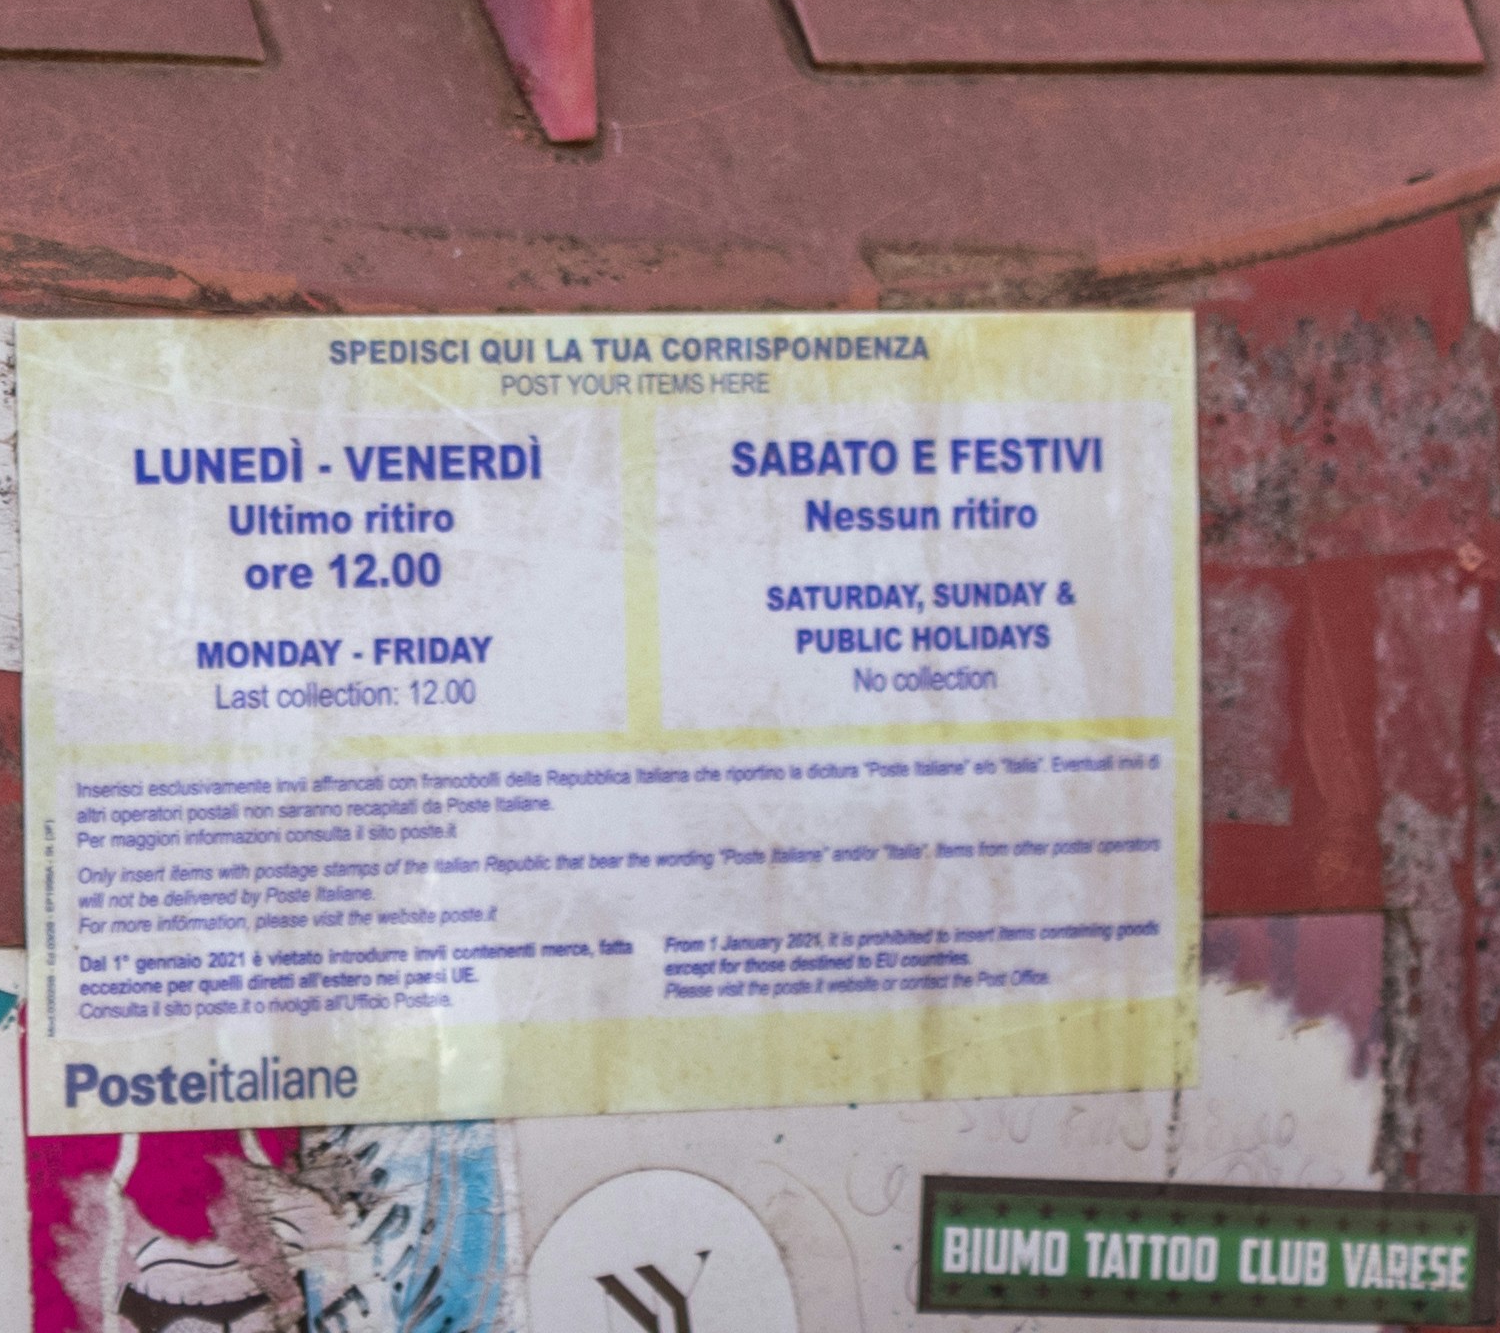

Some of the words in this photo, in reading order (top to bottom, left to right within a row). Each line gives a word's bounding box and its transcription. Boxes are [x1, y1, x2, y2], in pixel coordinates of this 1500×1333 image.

[328, 338, 471, 366] SPEDISCI
[480, 337, 535, 366] QUI
[545, 337, 582, 364] LA
[592, 336, 653, 364] TUA
[661, 335, 930, 363] CORRISPONDENZA
[501, 374, 562, 397] POST
[567, 373, 632, 396] YOUR
[637, 372, 705, 395] ITEMS
[710, 371, 770, 394] HERE
[134, 436, 304, 486] LUNEDÌ
[344, 434, 543, 482] VENERDÌ
[731, 438, 899, 478] SABATO
[912, 439, 937, 475] E
[949, 436, 1104, 474] FESTIVI
[228, 502, 352, 536] Ultimo
[365, 501, 455, 534] ritiro
[805, 498, 941, 533] Nessun
[951, 496, 1038, 530] ritiro
[244, 562, 314, 592] ore
[328, 552, 442, 589] 12.00
[766, 582, 925, 614] SATURDAY,
[933, 581, 1047, 609] SUNDAY
[1055, 579, 1077, 607] &
[196, 638, 342, 670] MONDAY
[374, 635, 493, 666] FRIDAY
[795, 626, 902, 655] PUBLIC
[912, 623, 1051, 652] HOLIDAYS
[215, 683, 270, 710] Last
[276, 680, 399, 709] collection:
[409, 678, 477, 706] 12.00
[854, 667, 887, 692] No
[893, 665, 998, 691] collection
[77, 782, 143, 799] Inserisci
[149, 779, 272, 796] esclusivamente
[313, 775, 384, 792] affrancati
[389, 776, 416, 791] con
[506, 771, 542, 787] della
[547, 769, 631, 789] Repubblica
[77, 807, 106, 824] altri
[111, 805, 182, 825] operatori
[187, 803, 239, 822] postali
[244, 804, 274, 819] non
[278, 803, 343, 818] saranno
[347, 798, 417, 817] recapitati
[422, 798, 442, 815] da
[447, 797, 491, 814] Poste
[77, 832, 106, 849] Per
[111, 830, 180, 851] maggiori
[185, 827, 281, 847] informazioni
[285, 826, 351, 844] consulta
[368, 824, 397, 841] sito
[400, 823, 457, 843] poste.it
[78, 866, 116, 888] Only
[120, 865, 165, 883] insert
[170, 864, 213, 882] items
[218, 863, 250, 881] with
[255, 862, 318, 883] postage
[323, 861, 380, 882] stamps
[384, 859, 404, 876] of
[404, 858, 429, 875] the
[78, 892, 104, 909] will
[109, 891, 134, 908] not
[138, 890, 159, 908] be
[163, 888, 237, 907] delivered
[241, 887, 260, 908] by
[265, 886, 311, 904] Poste
[78, 917, 107, 934] For
[111, 918, 152, 933] more
[157, 914, 250, 933] information,
[255, 912, 309, 931] please
[313, 911, 344, 928] visit
[348, 910, 373, 927] the
[377, 908, 435, 926] website
[439, 905, 498, 924] poste.it
[79, 955, 107, 973] Dal
[135, 952, 202, 974] gennaio
[208, 951, 246, 969] 2021
[252, 950, 262, 967] è
[269, 949, 322, 967] vietato
[329, 947, 408, 965] introdurre
[453, 942, 535, 961] contenenti
[540, 941, 594, 958] merce,
[599, 939, 633, 956] fatta
[79, 979, 162, 996] eccezione
[167, 979, 194, 998] per
[199, 975, 243, 994] quelli
[248, 973, 294, 991] diretti
[299, 971, 372, 989] all'estero
[377, 970, 400, 987] nei
[404, 970, 447, 990] paesi
[452, 967, 479, 984] UE.
[64, 1056, 358, 1109] Posteitaliane
[942, 1225, 1068, 1278] BIUMO
[1083, 1230, 1220, 1284] TATTOO
[1238, 1237, 1330, 1289] CLUB
[1341, 1241, 1470, 1293] VARESE
